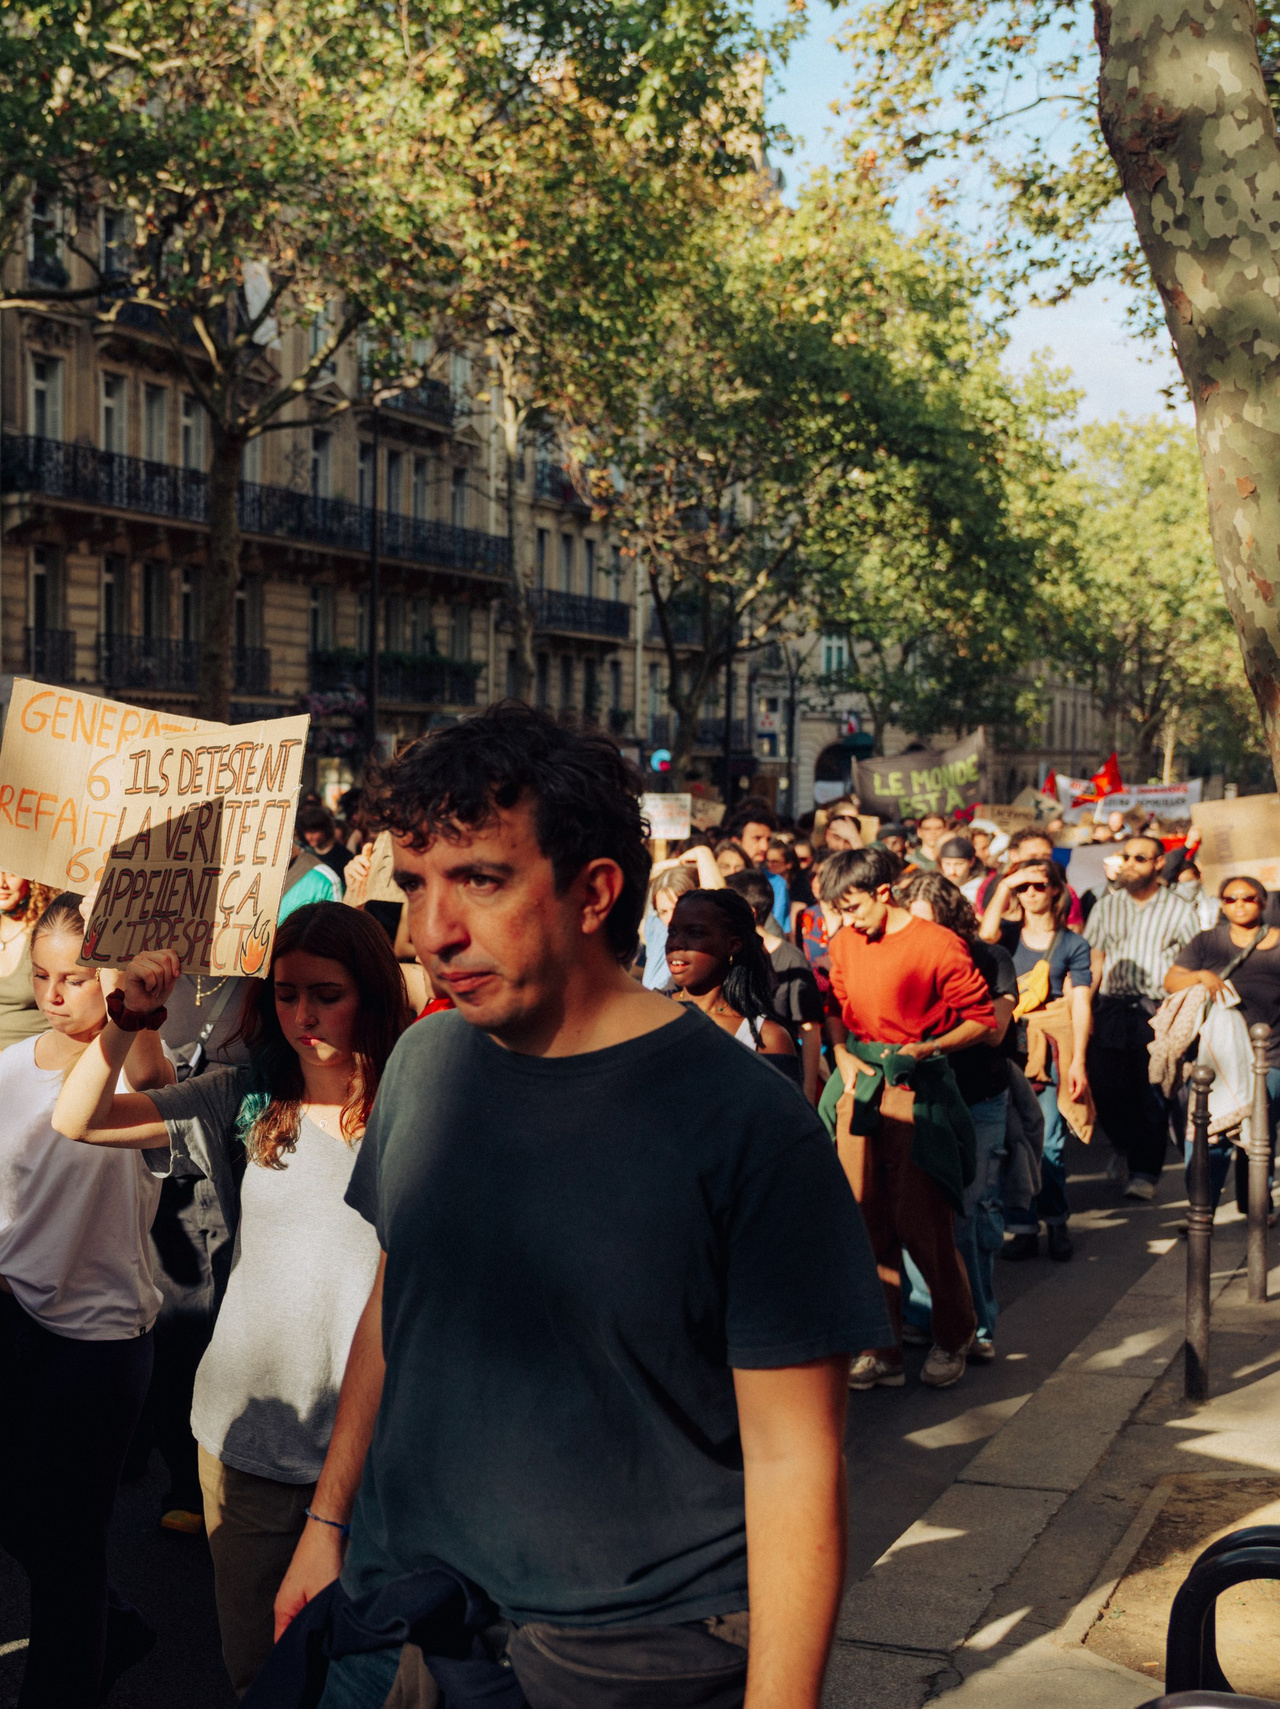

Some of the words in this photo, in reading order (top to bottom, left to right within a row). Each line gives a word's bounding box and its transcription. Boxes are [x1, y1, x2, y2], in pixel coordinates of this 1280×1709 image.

[125, 748, 174, 797] ILS
[178, 739, 303, 796] DETESTENT
[873, 771, 906, 796] LE
[910, 752, 979, 795] MONDE
[898, 792, 941, 819] EST
[111, 806, 152, 861] LA
[91, 867, 223, 920] APPELLENT
[220, 870, 261, 927] ÇA
